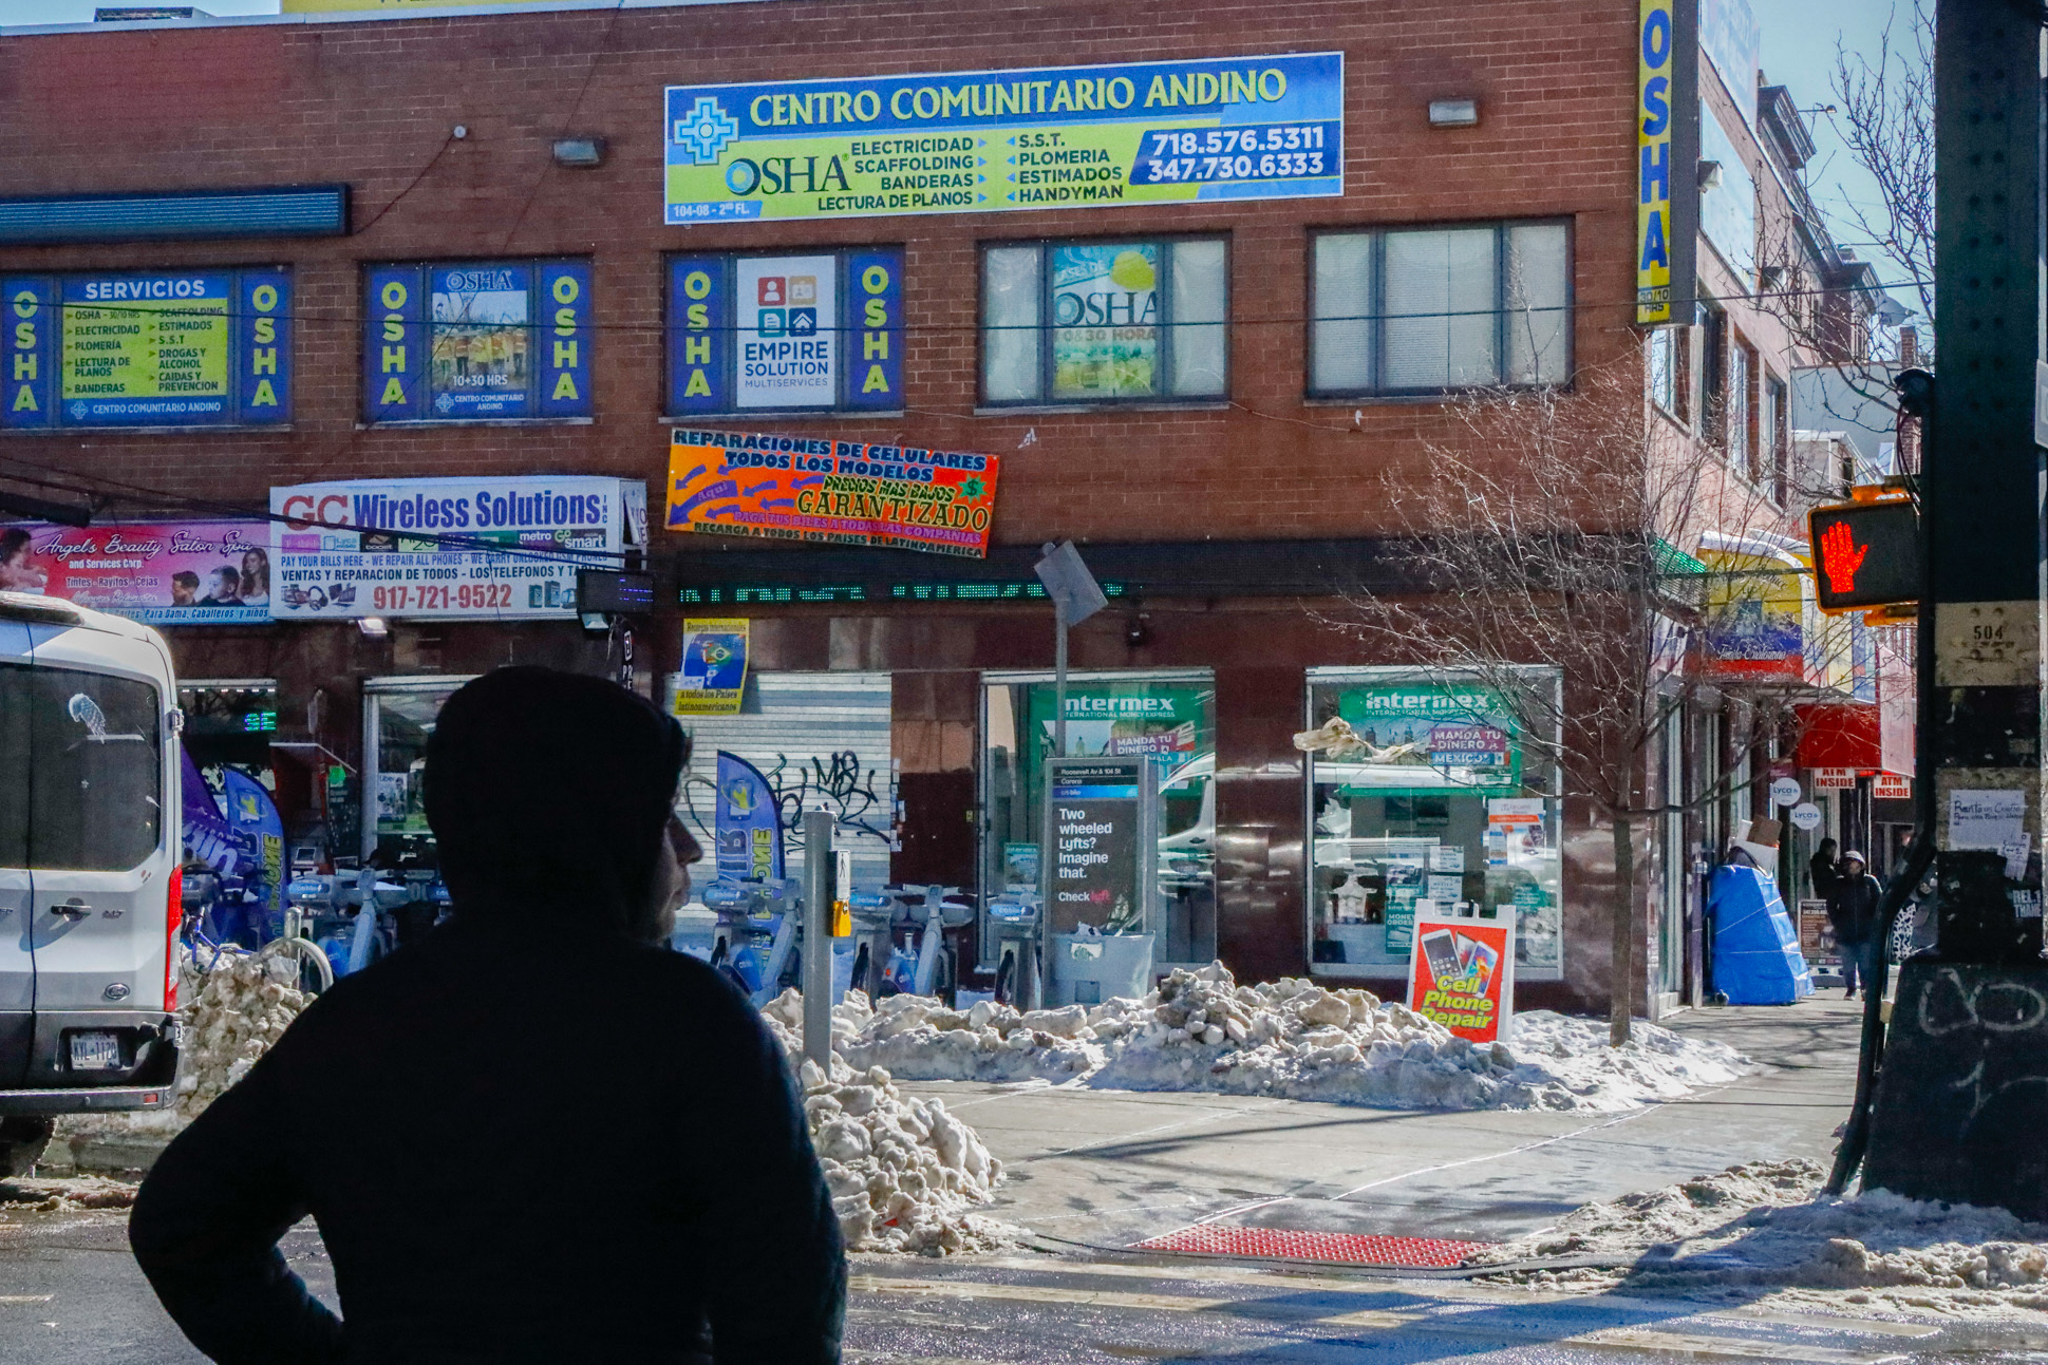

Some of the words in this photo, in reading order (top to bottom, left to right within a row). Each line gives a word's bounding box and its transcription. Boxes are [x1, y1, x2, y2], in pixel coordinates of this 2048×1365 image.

[750, 90, 881, 127] CENTRO
[890, 77, 1136, 120] COMUNITARIO
[1144, 68, 1287, 108] ANDINO
[851, 137, 974, 156] ELECTRICIDAD
[1019, 132, 1065, 148] S.S.T.
[1152, 126, 1324, 156] 718.576.5311
[1641, 9, 1671, 271] OSHA
[1019, 148, 1110, 166] PLOMERIA
[854, 156, 974, 174] SCAFFOLDING
[1147, 152, 1324, 182] 347.730.6333
[724, 153, 852, 196] OSHA
[881, 173, 974, 191] BANDERAS
[1019, 166, 1122, 184] ESTIMADOS
[818, 195, 885, 211] LECTURA
[888, 194, 908, 208] DE
[912, 191, 973, 207] PLANOS
[1019, 184, 1124, 203] HANDYMAN
[674, 204, 709, 217] 104-08
[447, 271, 513, 291] OSHA
[85, 280, 205, 300] SERVICIOS
[75, 310, 101, 320] OSHA
[1054, 290, 1157, 327] OSHA
[75, 325, 140, 336] ELECTRICIDAD
[159, 321, 212, 331] ESTIMADOS
[861, 265, 889, 394] OSHA
[159, 335, 185, 345] S.S.T
[552, 276, 580, 400] OSHA
[684, 270, 712, 398] OSHA
[252, 284, 278, 407] OSHA
[380, 282, 407, 405] OSHA
[745, 341, 828, 361] EMPIRE
[13, 291, 39, 412] OSHA
[159, 349, 196, 359] DROGAS
[197, 348, 206, 358] Y
[75, 357, 116, 368] LECTURA
[118, 356, 131, 366] DE
[159, 359, 202, 369] ALCOHOL
[745, 361, 828, 377] SOLUTION
[75, 367, 112, 378] PLANOS
[159, 372, 193, 382] CAIDAS
[194, 371, 202, 380] Y
[75, 383, 126, 393] BANDERAS
[159, 381, 219, 391] PREVENCION
[453, 375, 485, 388] 10+30
[486, 374, 508, 386] HRS
[745, 377, 828, 388] MULTISERVICES
[455, 395, 480, 403] CENTRO
[480, 393, 525, 402] COMUNITARIO
[93, 404, 127, 414] CENTRO
[128, 402, 186, 413] COMUNITARIO
[188, 401, 221, 412] ANDINO
[477, 402, 503, 411] ANDINO
[674, 430, 831, 455] REPARACIONES
[836, 442, 864, 458] DE
[867, 445, 987, 471] CELULARES
[725, 451, 791, 470] TODOS
[795, 456, 833, 473] LOS
[839, 459, 934, 482] MODELOS
[909, 484, 956, 503] BAJOS
[282, 495, 349, 531] GC
[353, 493, 469, 529] Wireless
[475, 490, 600, 527] Solutions
[734, 511, 766, 524] PAGA
[798, 490, 990, 533] GARANTIZADO
[519, 530, 552, 542] metro
[694, 522, 750, 536] RECARGA
[752, 527, 761, 537] A
[762, 528, 800, 540] TODOS
[803, 531, 825, 542] LOS
[104, 533, 164, 561] Beauty
[168, 529, 214, 554] Salon
[564, 534, 604, 549] smart
[69, 559, 84, 569] and
[86, 559, 121, 569] Services
[281, 555, 296, 567] PAY
[298, 555, 318, 567] YOUR
[320, 555, 341, 567] BILLS
[343, 555, 363, 566] HERE
[371, 555, 388, 566] WE
[390, 555, 414, 566] REPAIR
[415, 554, 429, 566] ALL
[431, 554, 463, 566] PHONES
[471, 554, 487, 565] WE
[281, 569, 322, 581] VENTAS
[324, 569, 331, 581] Y
[334, 569, 402, 581] REPARACION
[405, 569, 419, 580] DE
[423, 567, 458, 580] TODOS
[469, 566, 490, 579] LOS
[493, 565, 554, 578] TELEFONOS
[556, 565, 564, 577] Y
[66, 576, 91, 588] Tintes
[374, 583, 512, 610] 917-721-9522
[144, 609, 163, 619] Para
[1973, 626, 2003, 640] 504
[1065, 695, 1174, 711] ntermex
[1366, 692, 1490, 709] intermex
[1117, 736, 1156, 746] MANDA
[1158, 735, 1172, 743] TU
[1434, 730, 1481, 740] MANDA
[1485, 730, 1501, 740] TU
[1117, 744, 1157, 755] DINERO
[1437, 740, 1486, 750] DINERO
[1816, 777, 1854, 788] INSIDE
[1881, 776, 1903, 786] ATM
[1875, 787, 1909, 797] INSIDE
[1059, 808, 1085, 820] Two
[1059, 822, 1112, 834] wheeled
[1059, 837, 1097, 851] Lyfts?
[1059, 852, 1109, 866] Imagine
[1058, 867, 1087, 878] that.
[1058, 892, 1090, 902] Check
[1436, 975, 1482, 994] Cell
[1422, 989, 1494, 1011] Phone
[1420, 1007, 1494, 1029] Repair
